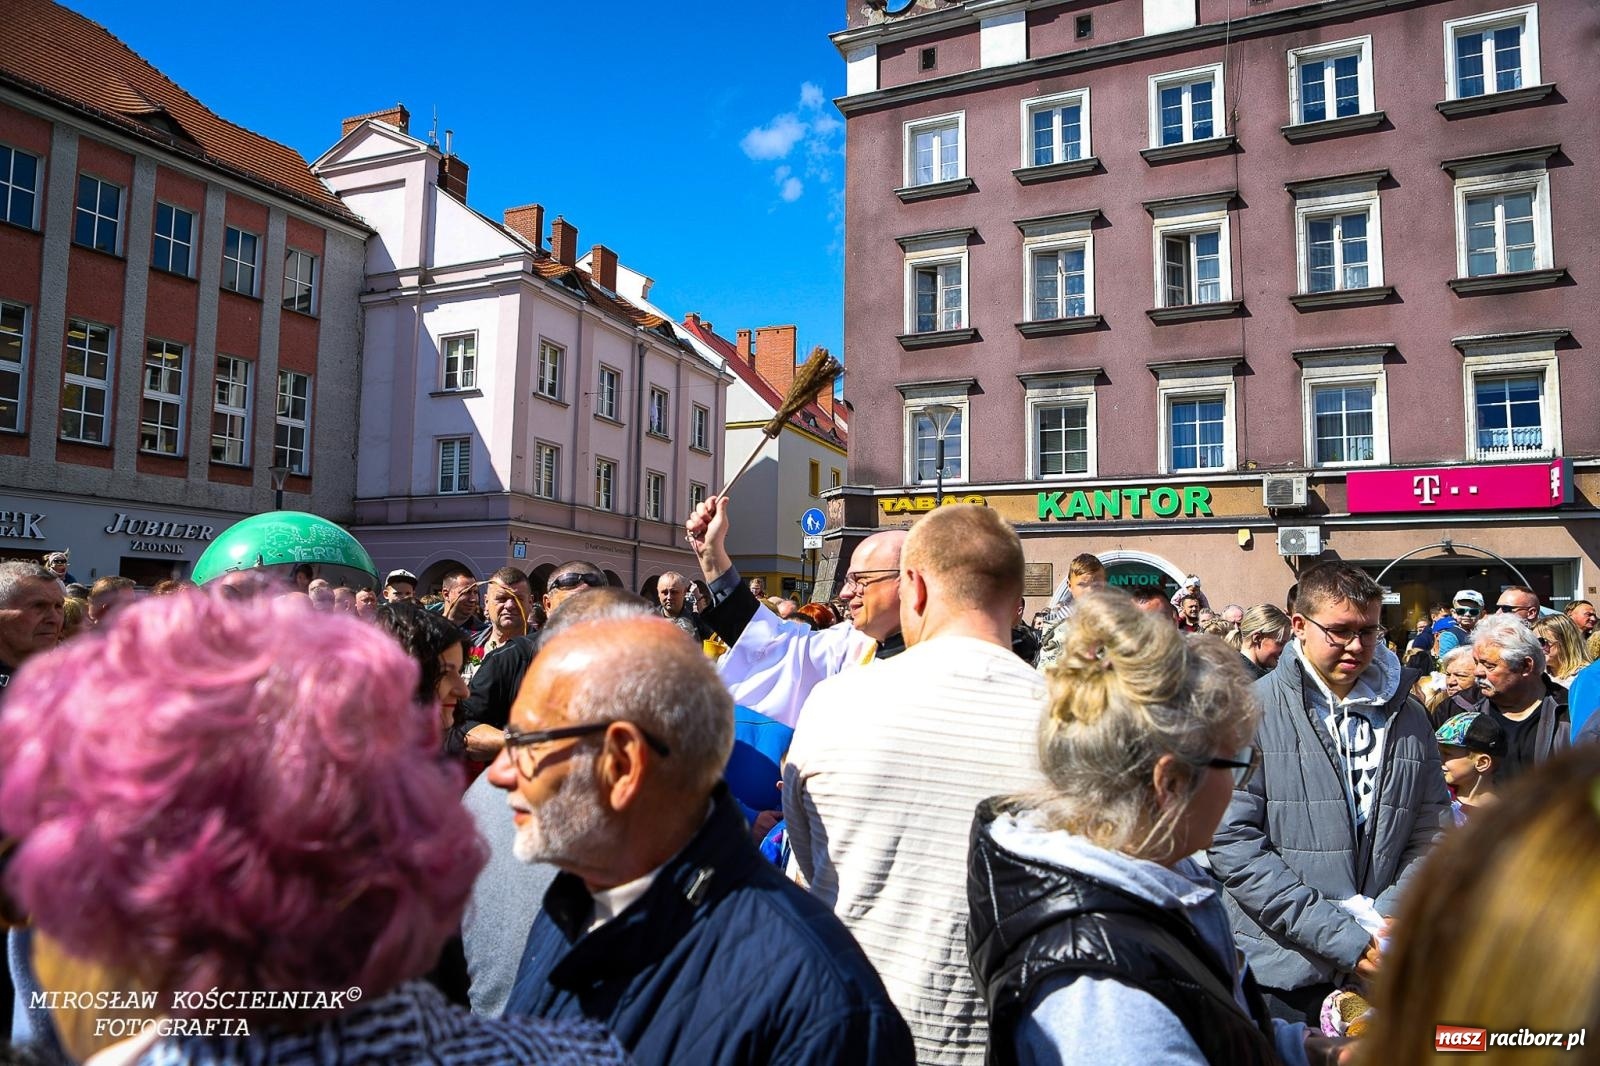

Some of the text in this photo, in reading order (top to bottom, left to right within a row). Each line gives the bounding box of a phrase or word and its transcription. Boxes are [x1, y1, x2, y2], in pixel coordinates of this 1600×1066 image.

[1037, 486, 1212, 519] KANTOR
[106, 513, 214, 540] JUBILER
[132, 540, 184, 553] ZŁOTNIK
[1108, 574, 1160, 586] ANTOR
